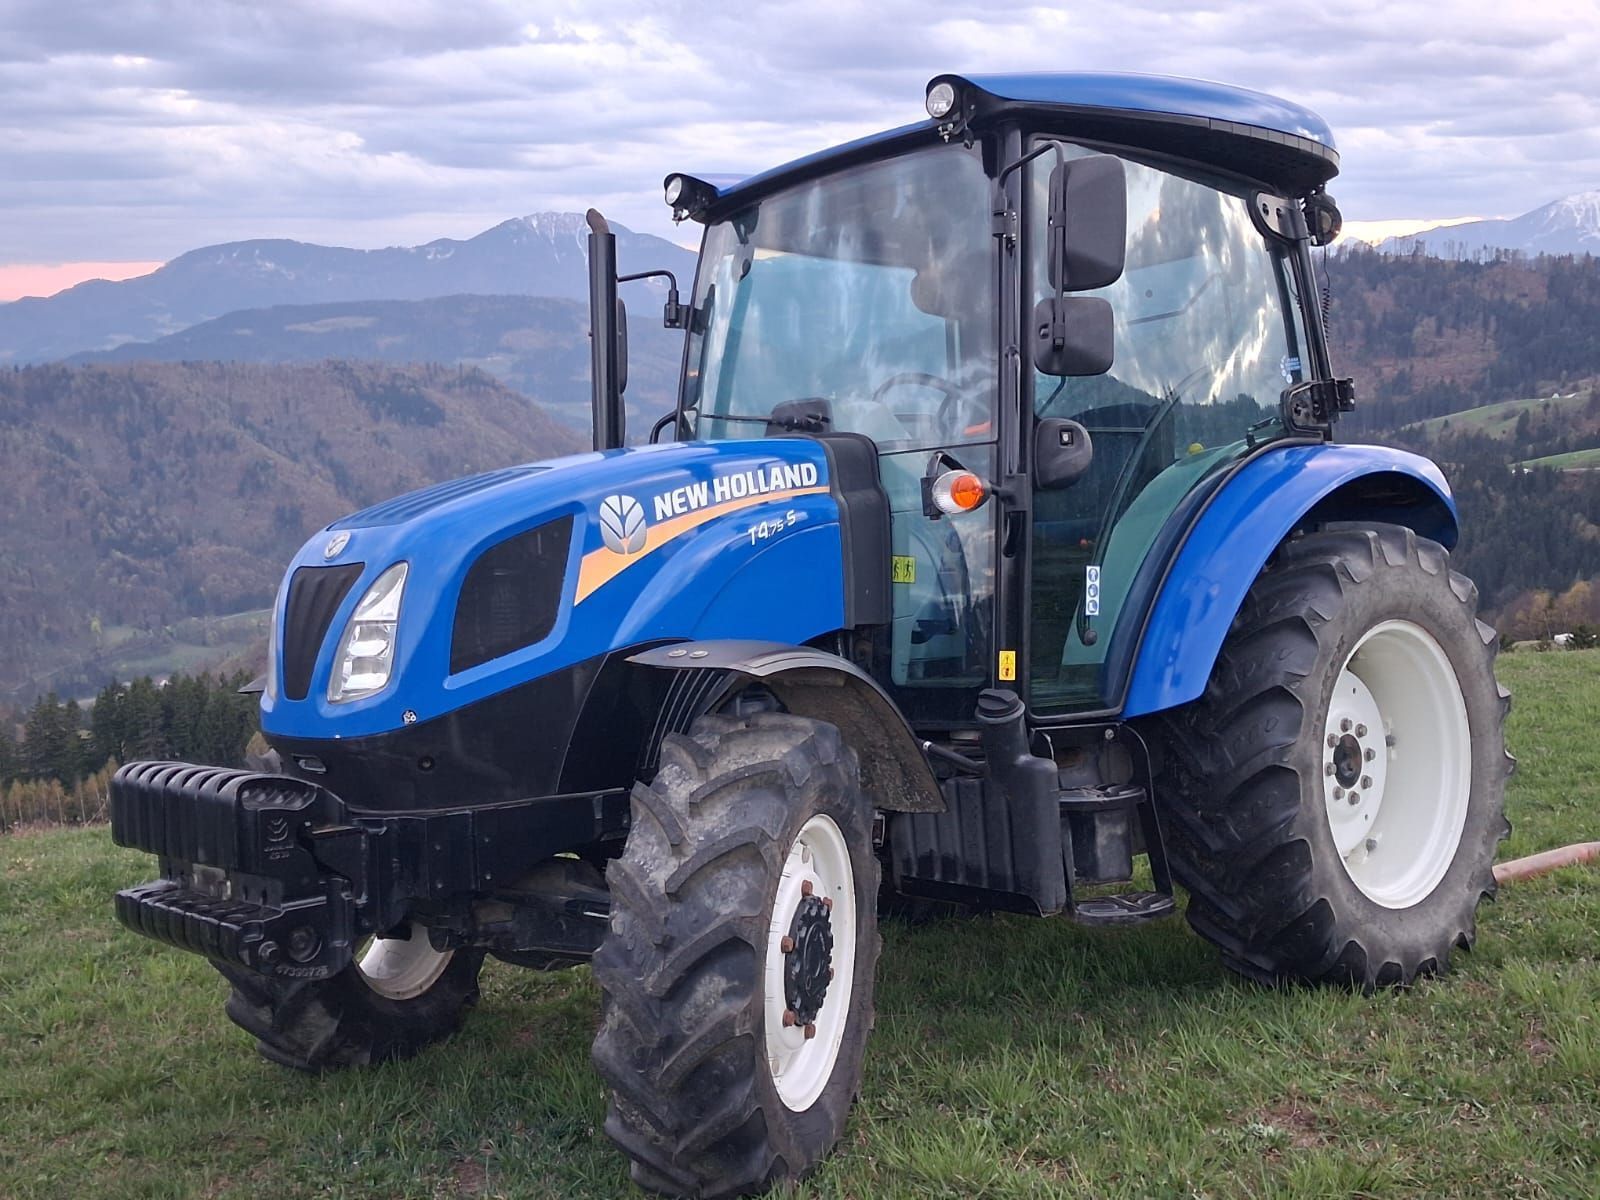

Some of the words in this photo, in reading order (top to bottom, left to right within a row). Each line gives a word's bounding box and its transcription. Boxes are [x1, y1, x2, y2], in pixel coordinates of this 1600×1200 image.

[653, 481, 708, 521] NEW
[713, 463, 817, 502] HOLLAND
[786, 509, 796, 526] S
